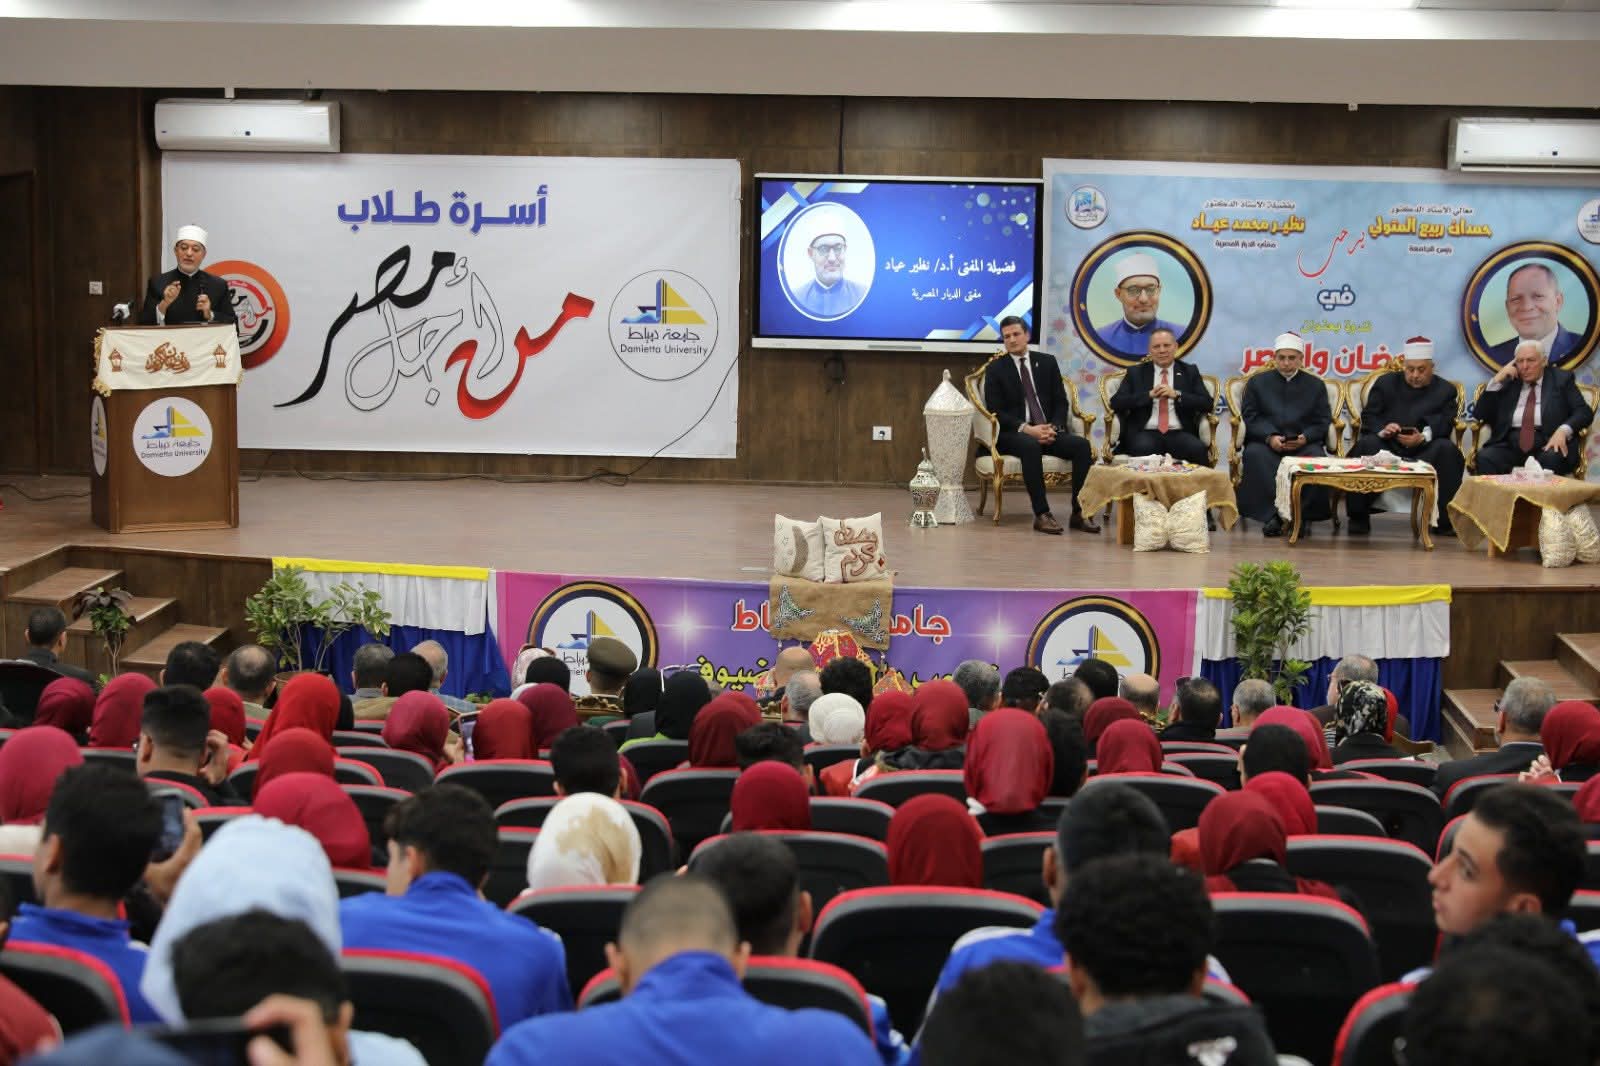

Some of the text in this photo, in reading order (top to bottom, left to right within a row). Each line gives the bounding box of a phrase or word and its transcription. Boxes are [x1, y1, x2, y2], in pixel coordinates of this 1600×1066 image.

[337, 184, 548, 233] أسرة طلاب
[1191, 212, 1306, 235] نظير محمد عياد
[1418, 222, 1445, 239] ربيع
[885, 257, 905, 272] عياد
[909, 257, 930, 273] نظير
[986, 259, 1016, 275] فضيلة
[911, 287, 939, 300] المصرية
[941, 288, 961, 301] الديار
[1317, 284, 1356, 311] في
[273, 244, 594, 420] من أجل مصر
[1301, 320, 1373, 334] ندوة بعنوان
[620, 344, 708, 356] Damietta University
[1241, 343, 1329, 376] واصر
[141, 448, 206, 459] Damietta University
[889, 603, 951, 644] جام
